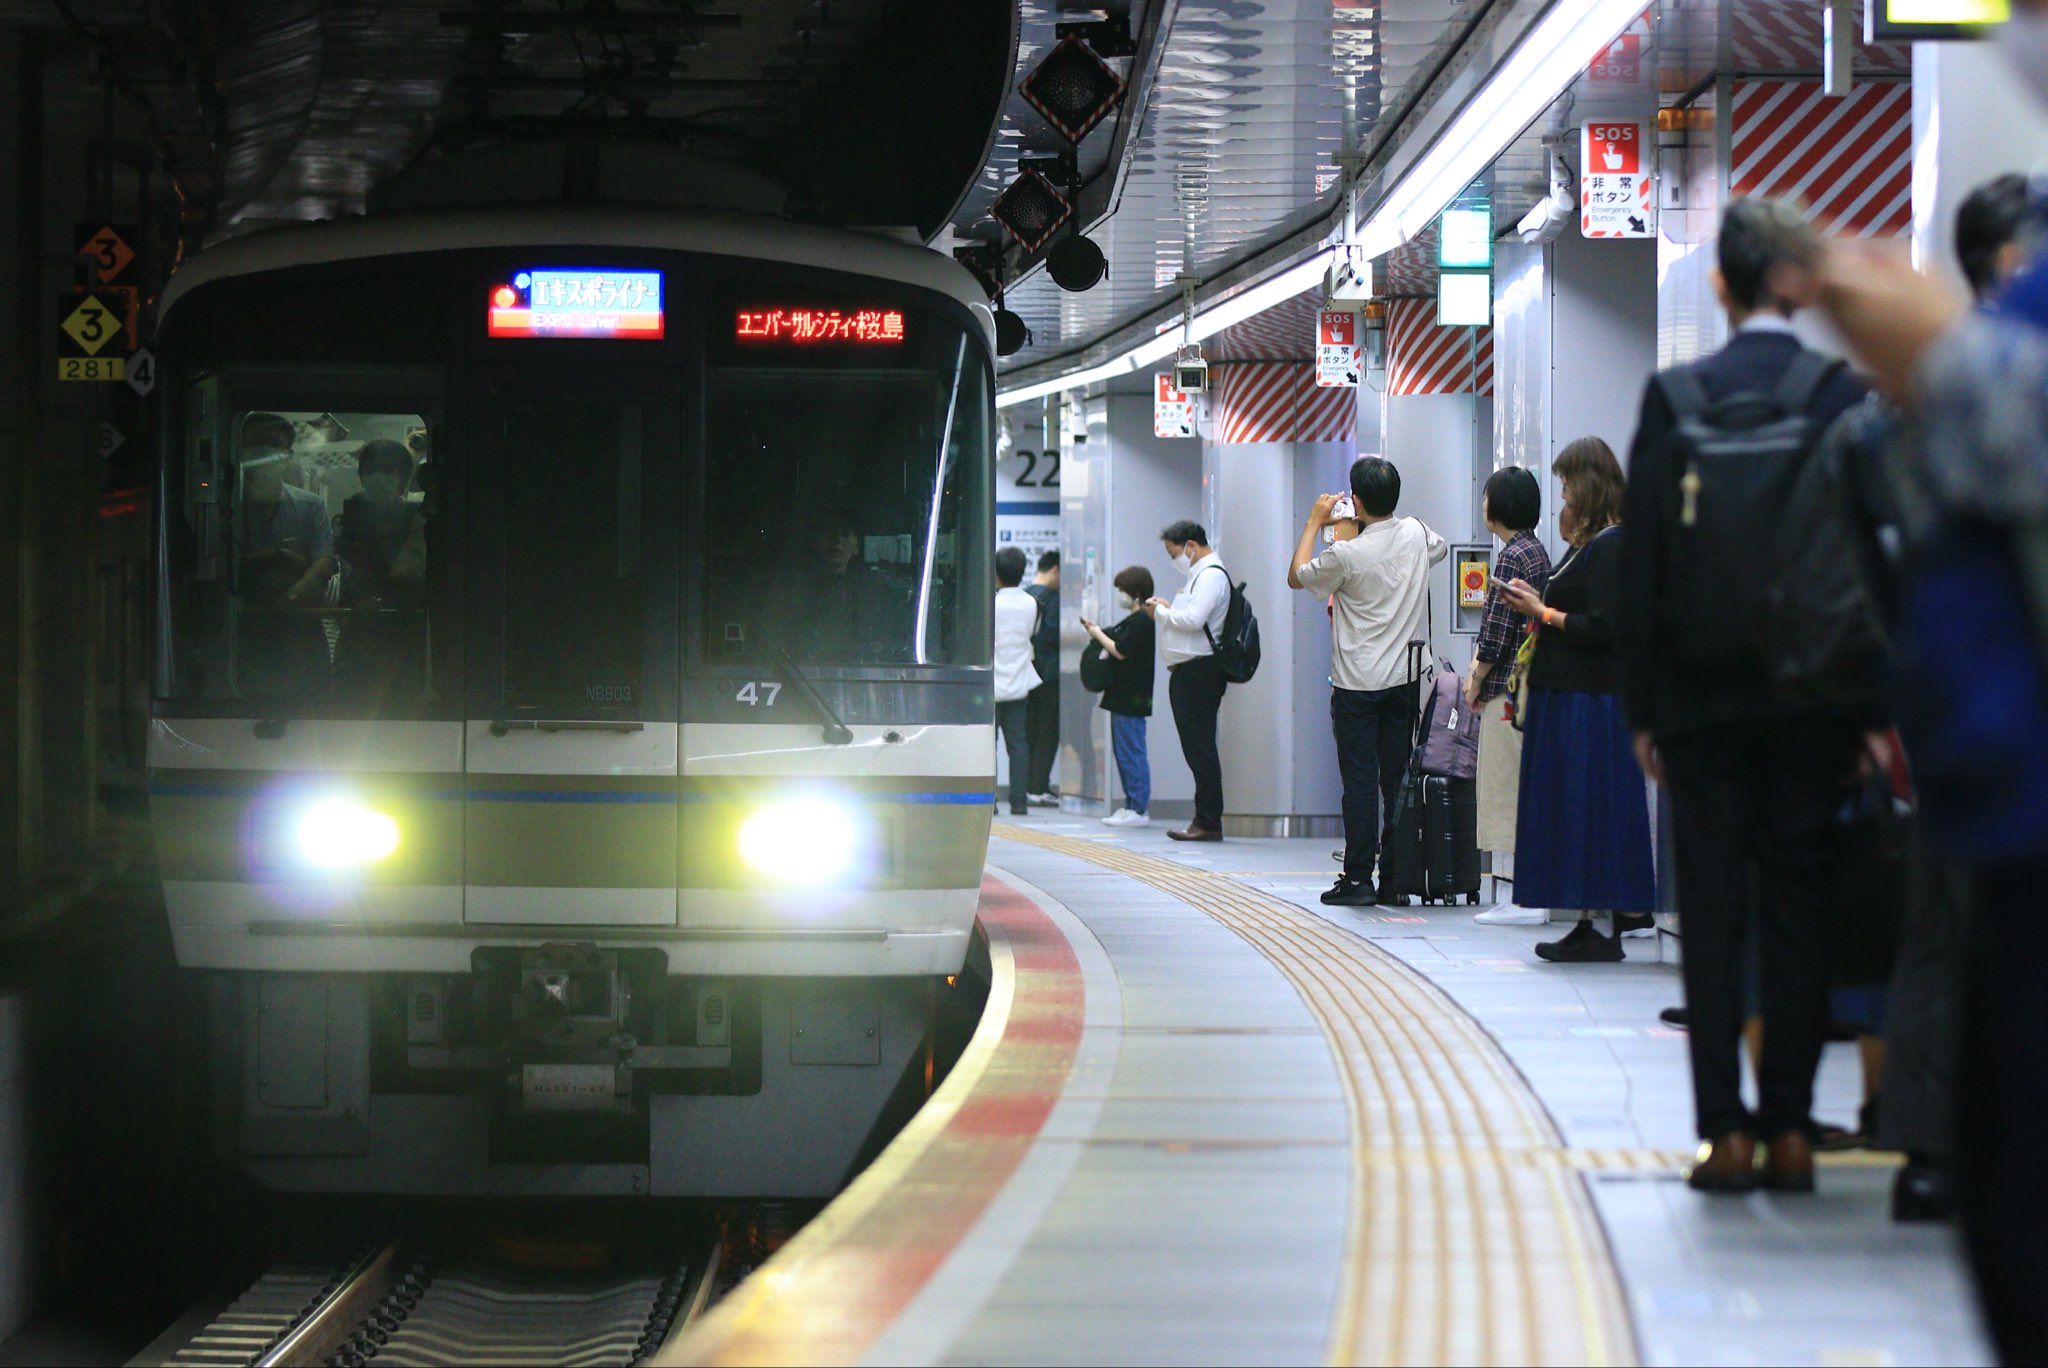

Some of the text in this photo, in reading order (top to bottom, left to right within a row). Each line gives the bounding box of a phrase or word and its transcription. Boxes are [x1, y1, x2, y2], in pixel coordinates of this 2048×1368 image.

[1594, 127, 1633, 141] SOS
[1591, 176, 1632, 190] 非常
[1591, 191, 1632, 203] ボタン
[1591, 206, 1632, 216] Emergency
[95, 238, 118, 271] 3
[534, 275, 658, 309] エキスポライナー
[80, 309, 104, 342] 3
[532, 312, 621, 329] EXPO Liner
[1325, 314, 1351, 324] SOS
[1323, 346, 1350, 355] 非常
[66, 360, 115, 378] 281
[1322, 356, 1350, 365] ボタン
[133, 358, 152, 386] 4
[1014, 449, 1061, 487] 22
[735, 681, 783, 707] 47
